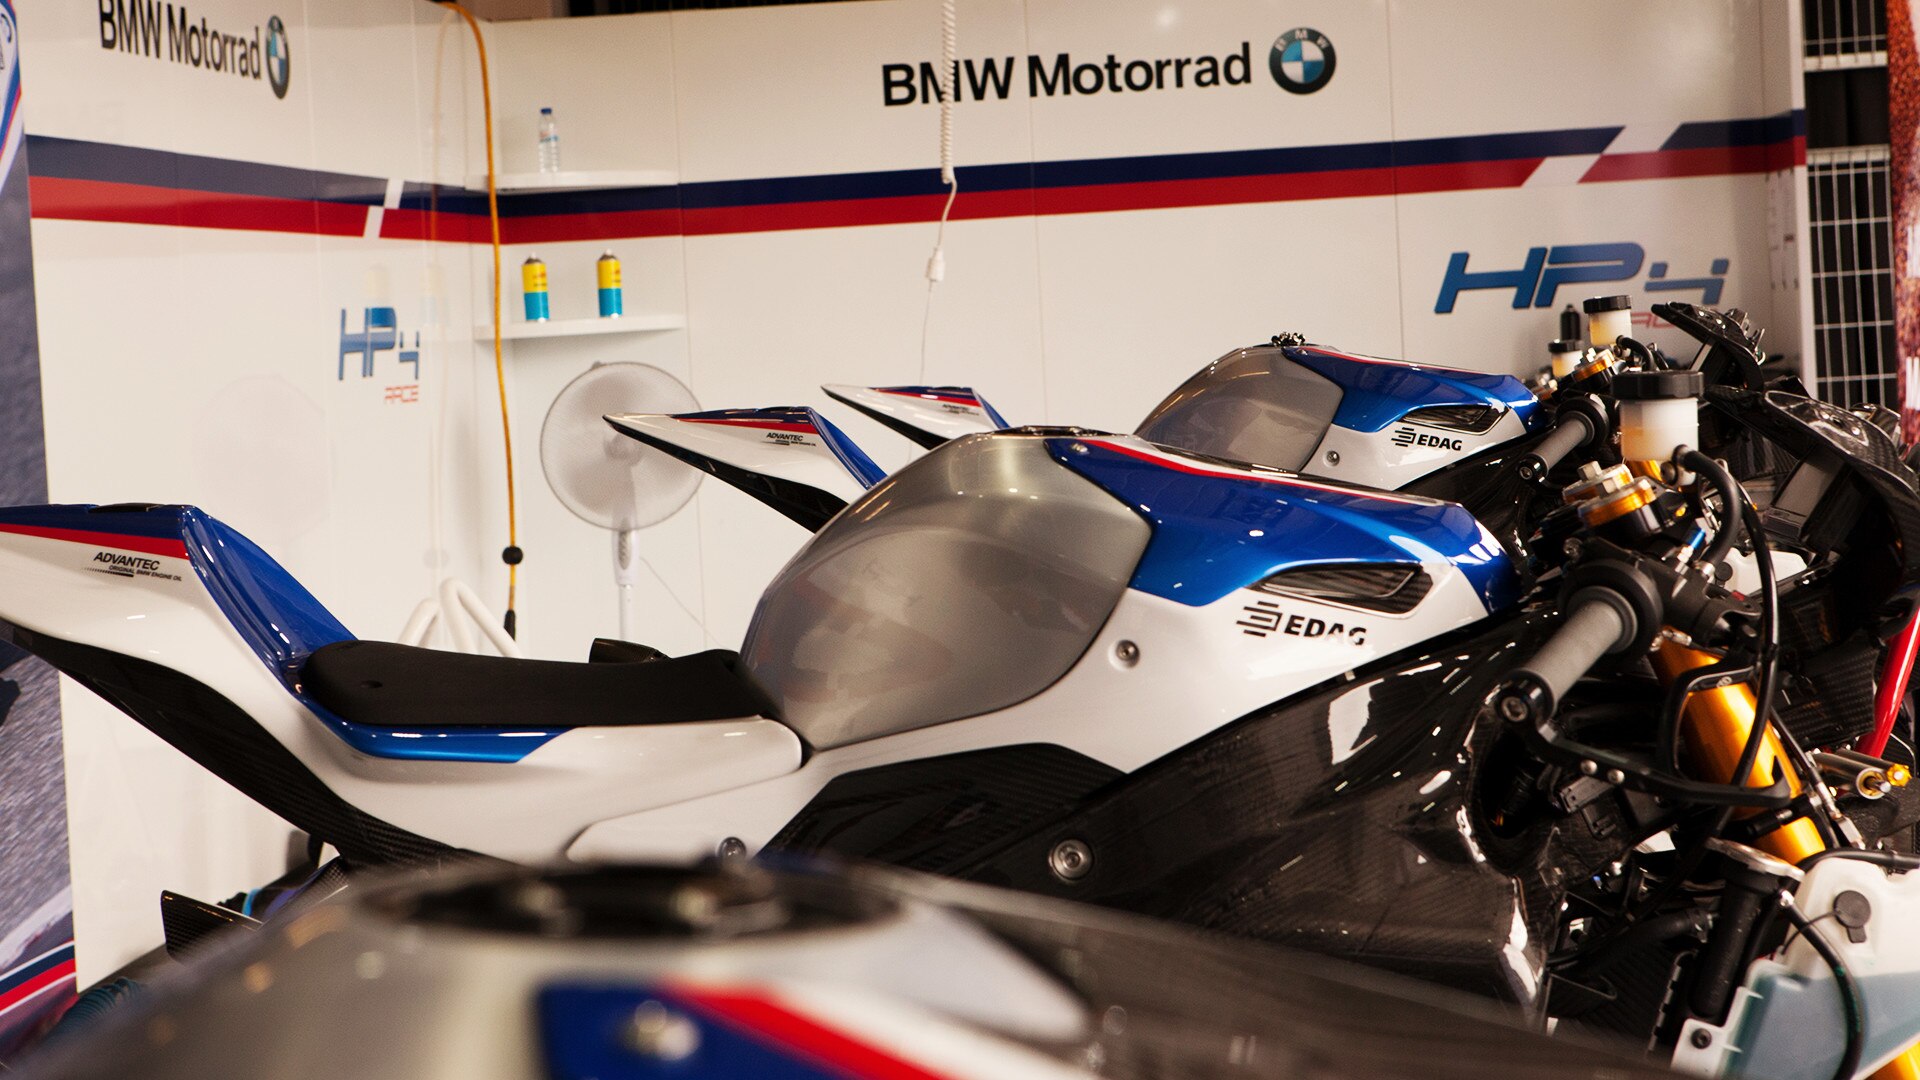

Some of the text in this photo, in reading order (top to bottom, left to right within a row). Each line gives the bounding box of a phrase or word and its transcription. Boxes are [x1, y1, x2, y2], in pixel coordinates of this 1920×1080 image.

[98, 0, 162, 59] BMW
[166, 2, 262, 80] Motorrad
[882, 41, 1252, 106] BMW Motorrad
[1434, 242, 1730, 314] HP4
[338, 307, 420, 381] HP4
[766, 431, 804, 442] ADVANTEC
[1417, 433, 1463, 452] EDAG
[93, 551, 161, 571] ADVANTEC
[109, 564, 135, 574] ORIGINAL
[136, 569, 151, 578] BMW
[151, 571, 173, 580] ENGINE
[1284, 613, 1367, 646] EDAG
